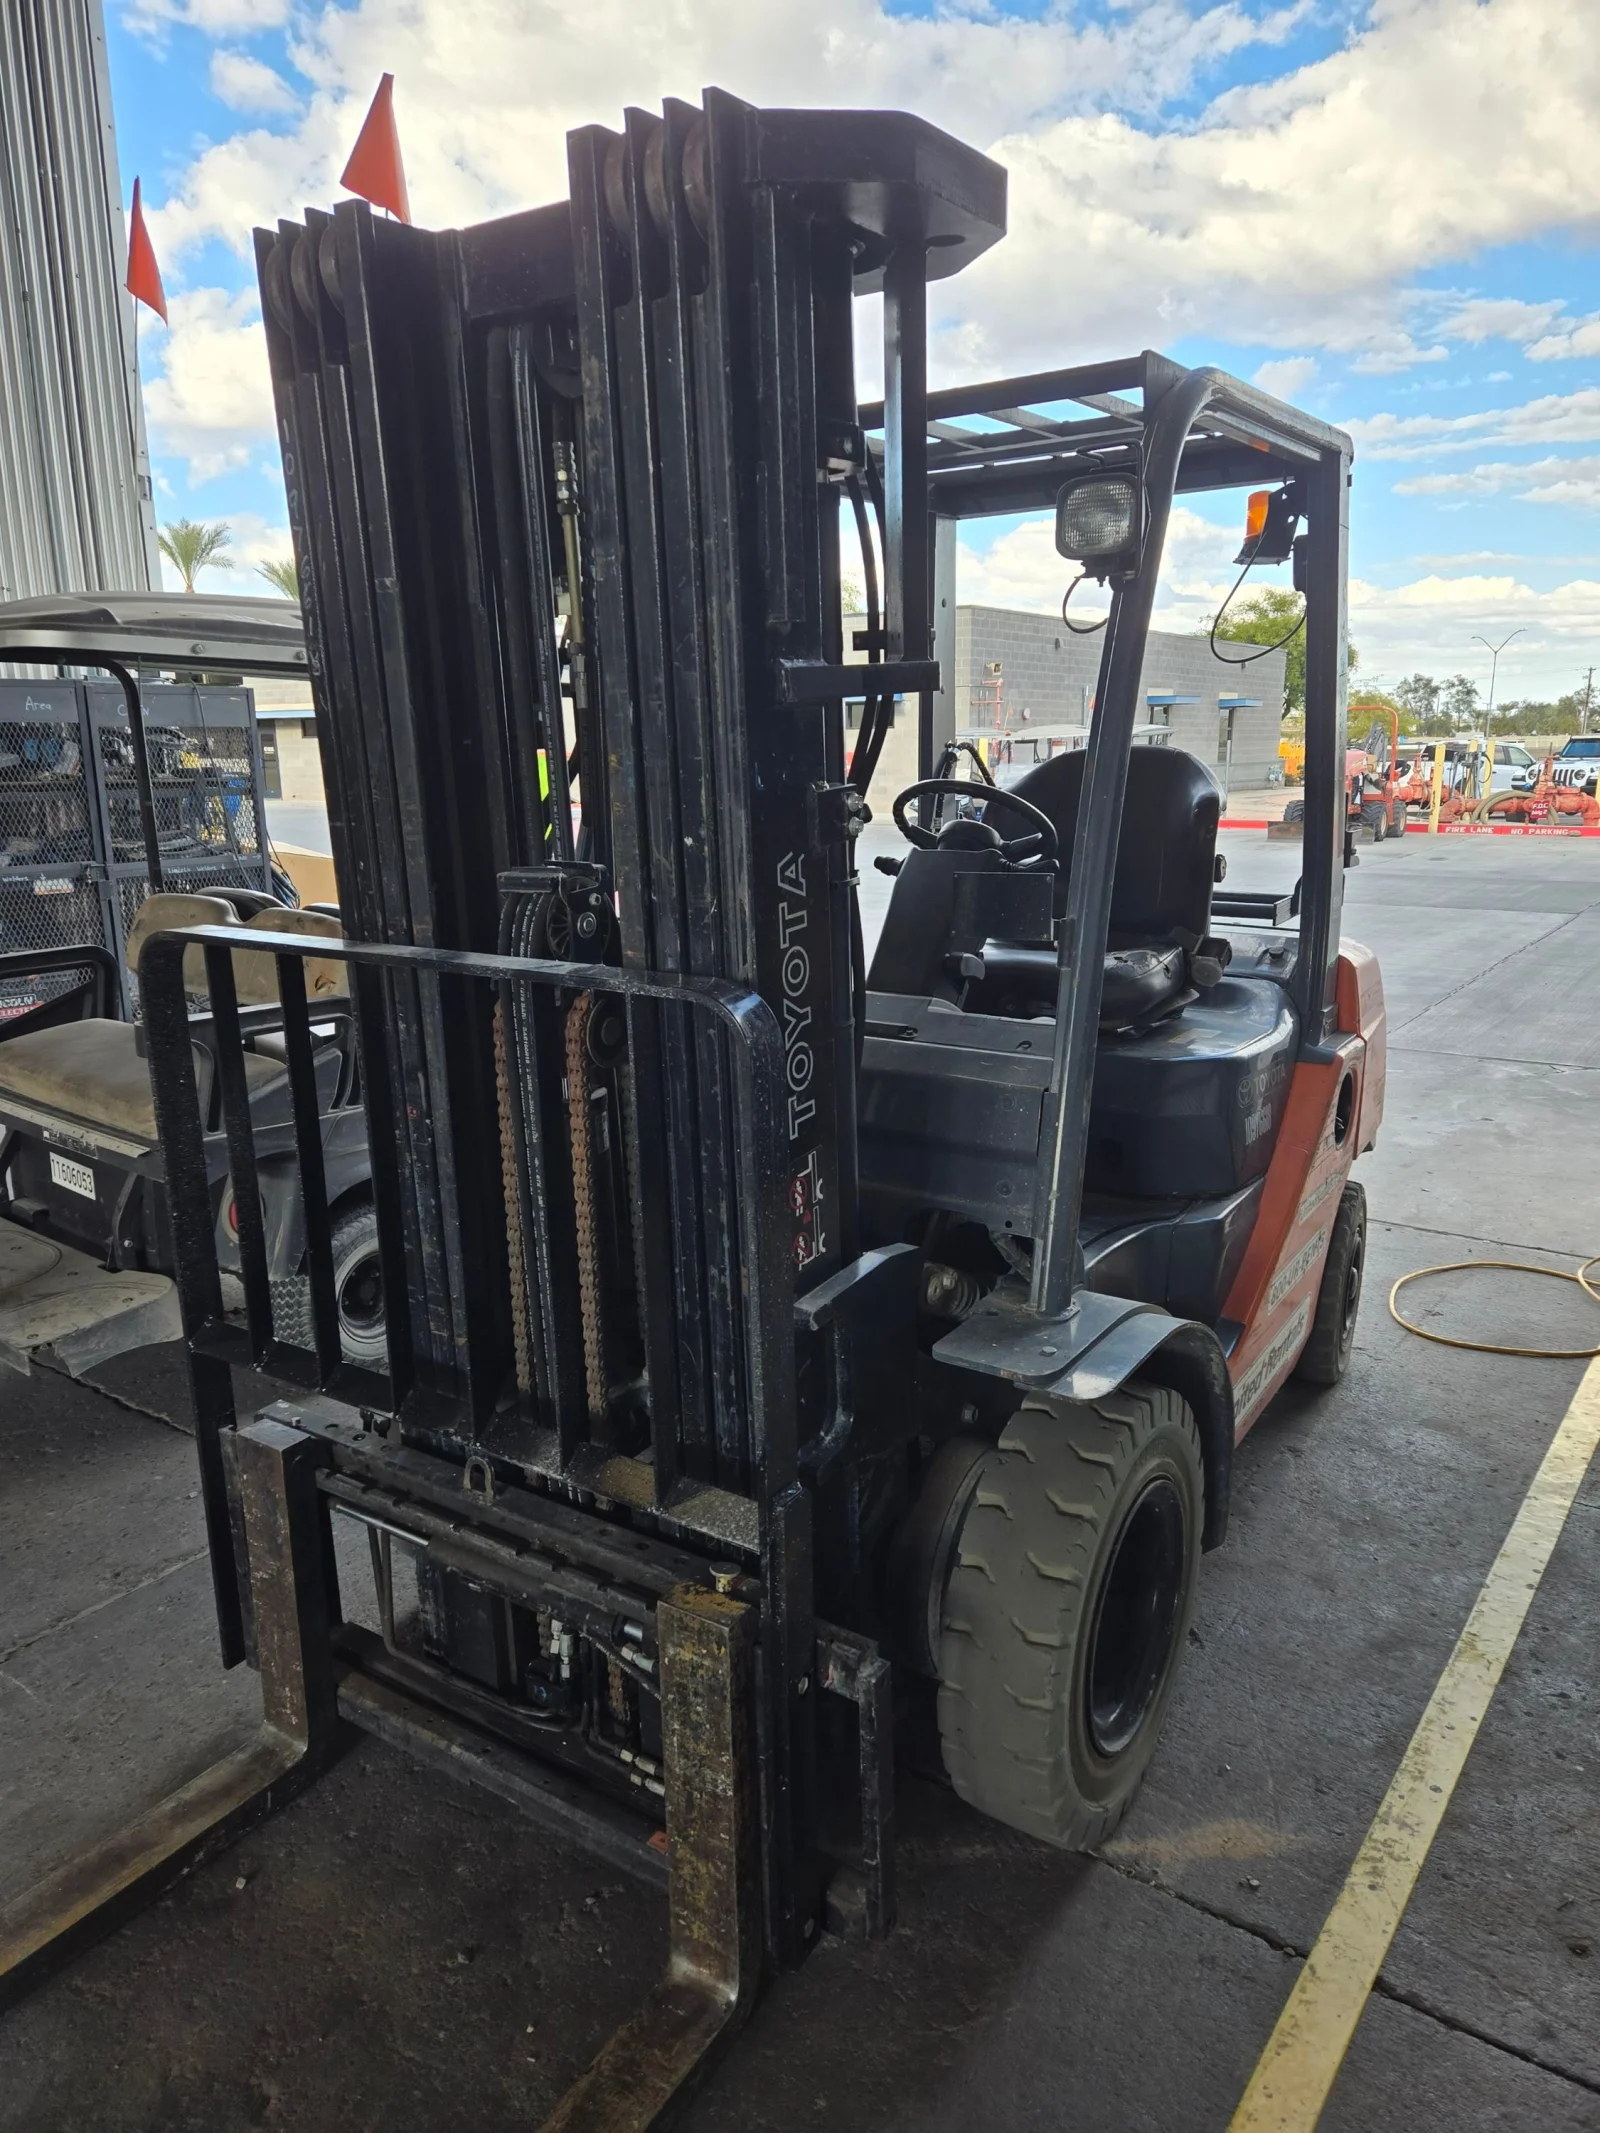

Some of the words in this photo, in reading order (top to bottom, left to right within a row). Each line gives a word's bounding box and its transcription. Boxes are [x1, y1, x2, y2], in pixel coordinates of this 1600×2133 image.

[25, 696, 52, 711] Area
[1445, 826, 1466, 834] FIRE
[1510, 828, 1523, 836] NO
[1528, 828, 1569, 836] PARKING
[777, 851, 816, 1141] TOYOTA
[1253, 1063, 1287, 1094] TOYOTA
[51, 1158, 93, 1193] 11606053
